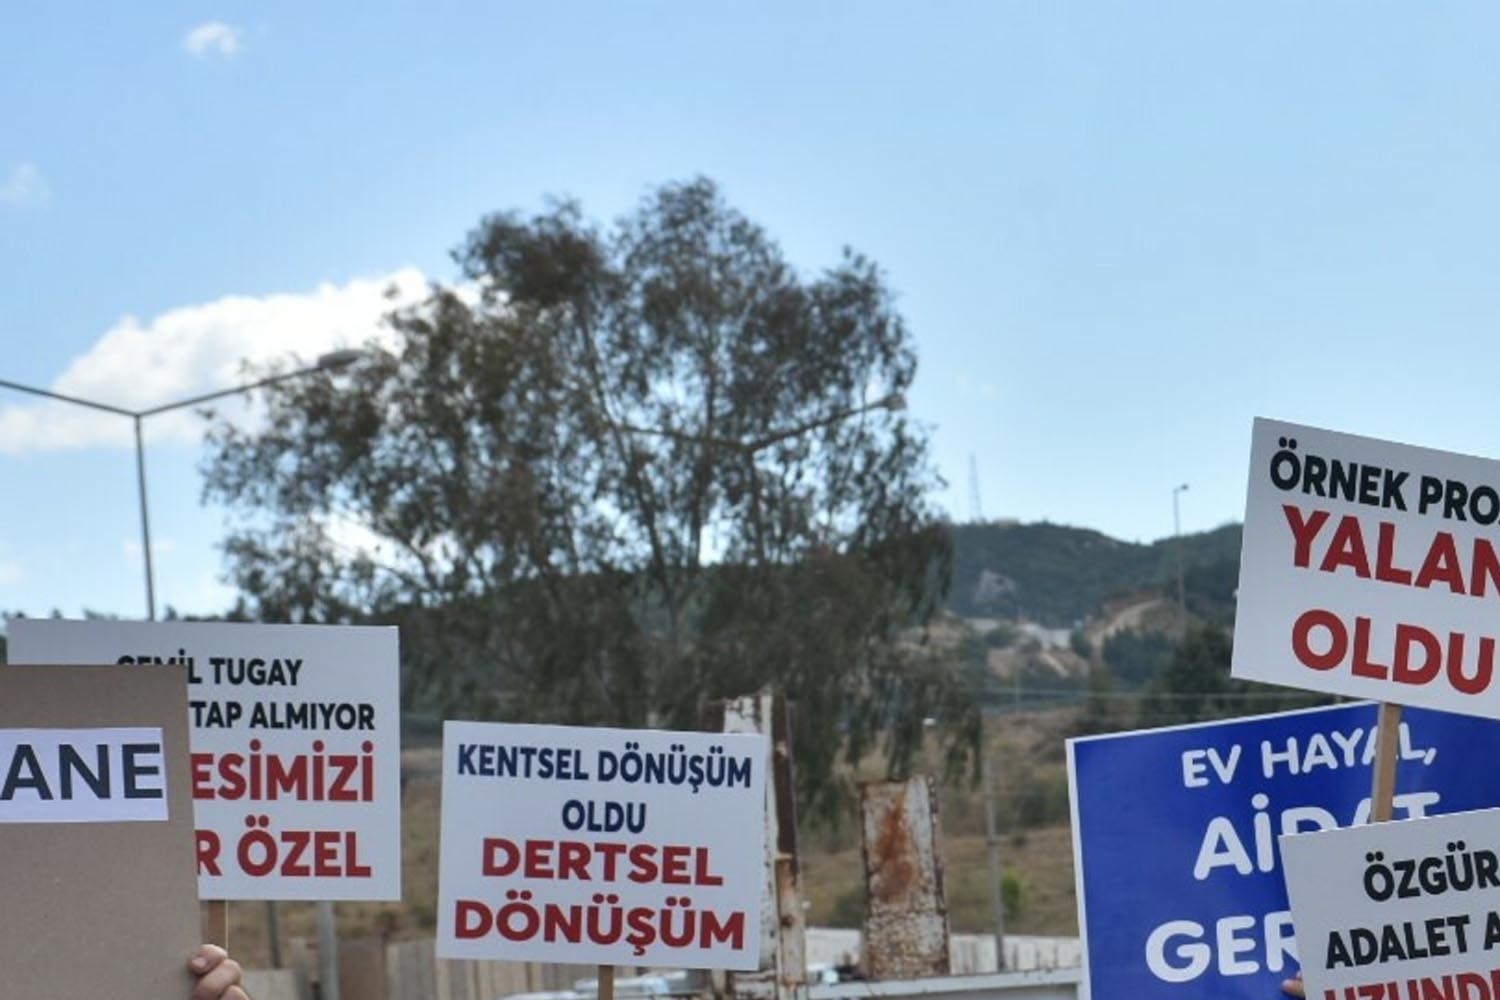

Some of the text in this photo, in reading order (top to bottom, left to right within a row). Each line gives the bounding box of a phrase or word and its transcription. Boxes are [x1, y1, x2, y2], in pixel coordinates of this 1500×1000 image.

[1270, 437, 1409, 511] ÖRNEK
[209, 658, 302, 685] TUGAY
[1293, 609, 1496, 694] OLDU
[249, 702, 374, 730] ALMIYOR
[0, 744, 162, 800] ANE
[458, 742, 751, 793] KENTSEL DÖNÜŞÜM
[1182, 745, 1241, 787] EV
[562, 800, 646, 833] OLDU
[238, 815, 372, 878] ÖZEL
[484, 838, 724, 887] DERTSEL
[455, 890, 747, 956] DÖNÜŞÜM
[1325, 906, 1468, 969] ADALET
